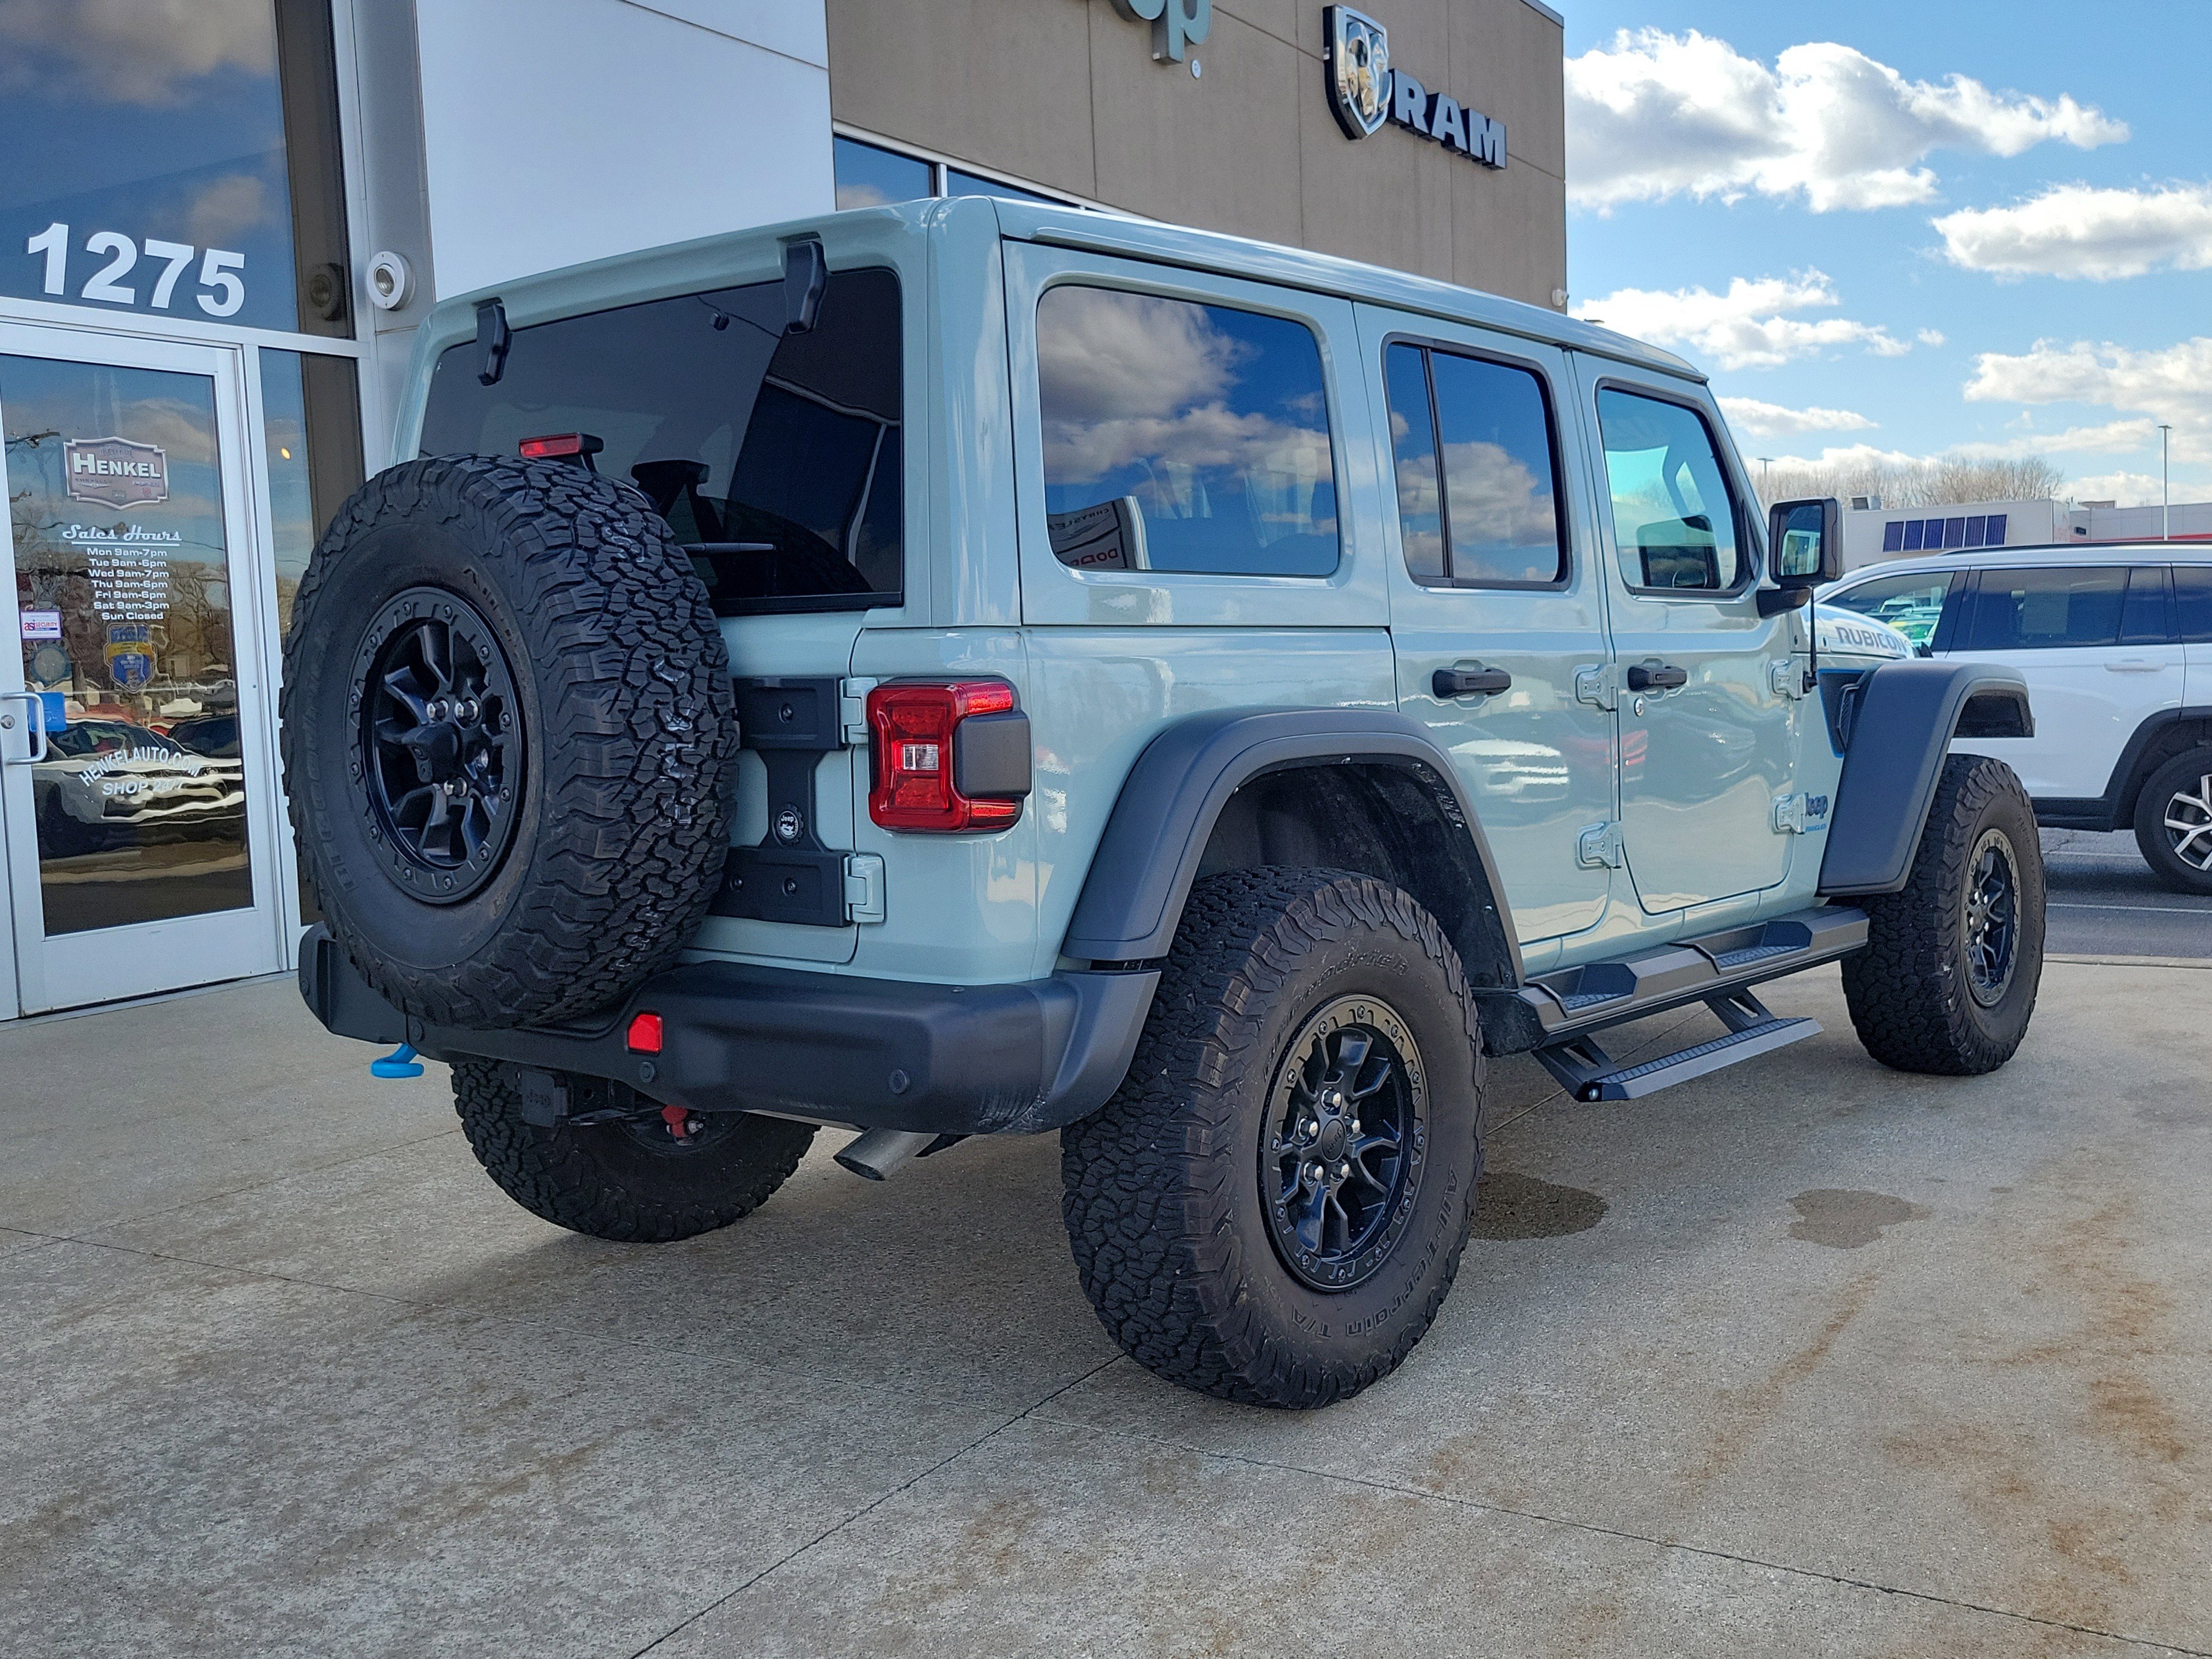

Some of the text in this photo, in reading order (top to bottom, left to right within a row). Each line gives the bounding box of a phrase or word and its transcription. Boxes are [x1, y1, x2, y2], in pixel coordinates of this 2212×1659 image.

[1390, 68, 1507, 170] RAM
[28, 222, 245, 317] 1275
[72, 453, 161, 479] HENKEL
[62, 524, 182, 541] Sales Hours
[87, 548, 167, 557] Mon 9am-7pm
[89, 558, 109, 567] Tue
[88, 569, 170, 579] Wed 9am-7pm
[92, 580, 168, 589] Thu 9am-6pm
[114, 591, 166, 600] 9am-6pm
[117, 602, 170, 611] 9am-3pm
[102, 612, 164, 620] Sun Closed
[1835, 626, 1908, 652] RUBICON
[79, 746, 202, 787] HENKELAUTO.COM
[101, 779, 184, 795] SHOP 24/7
[781, 815, 794, 823] Jeep
